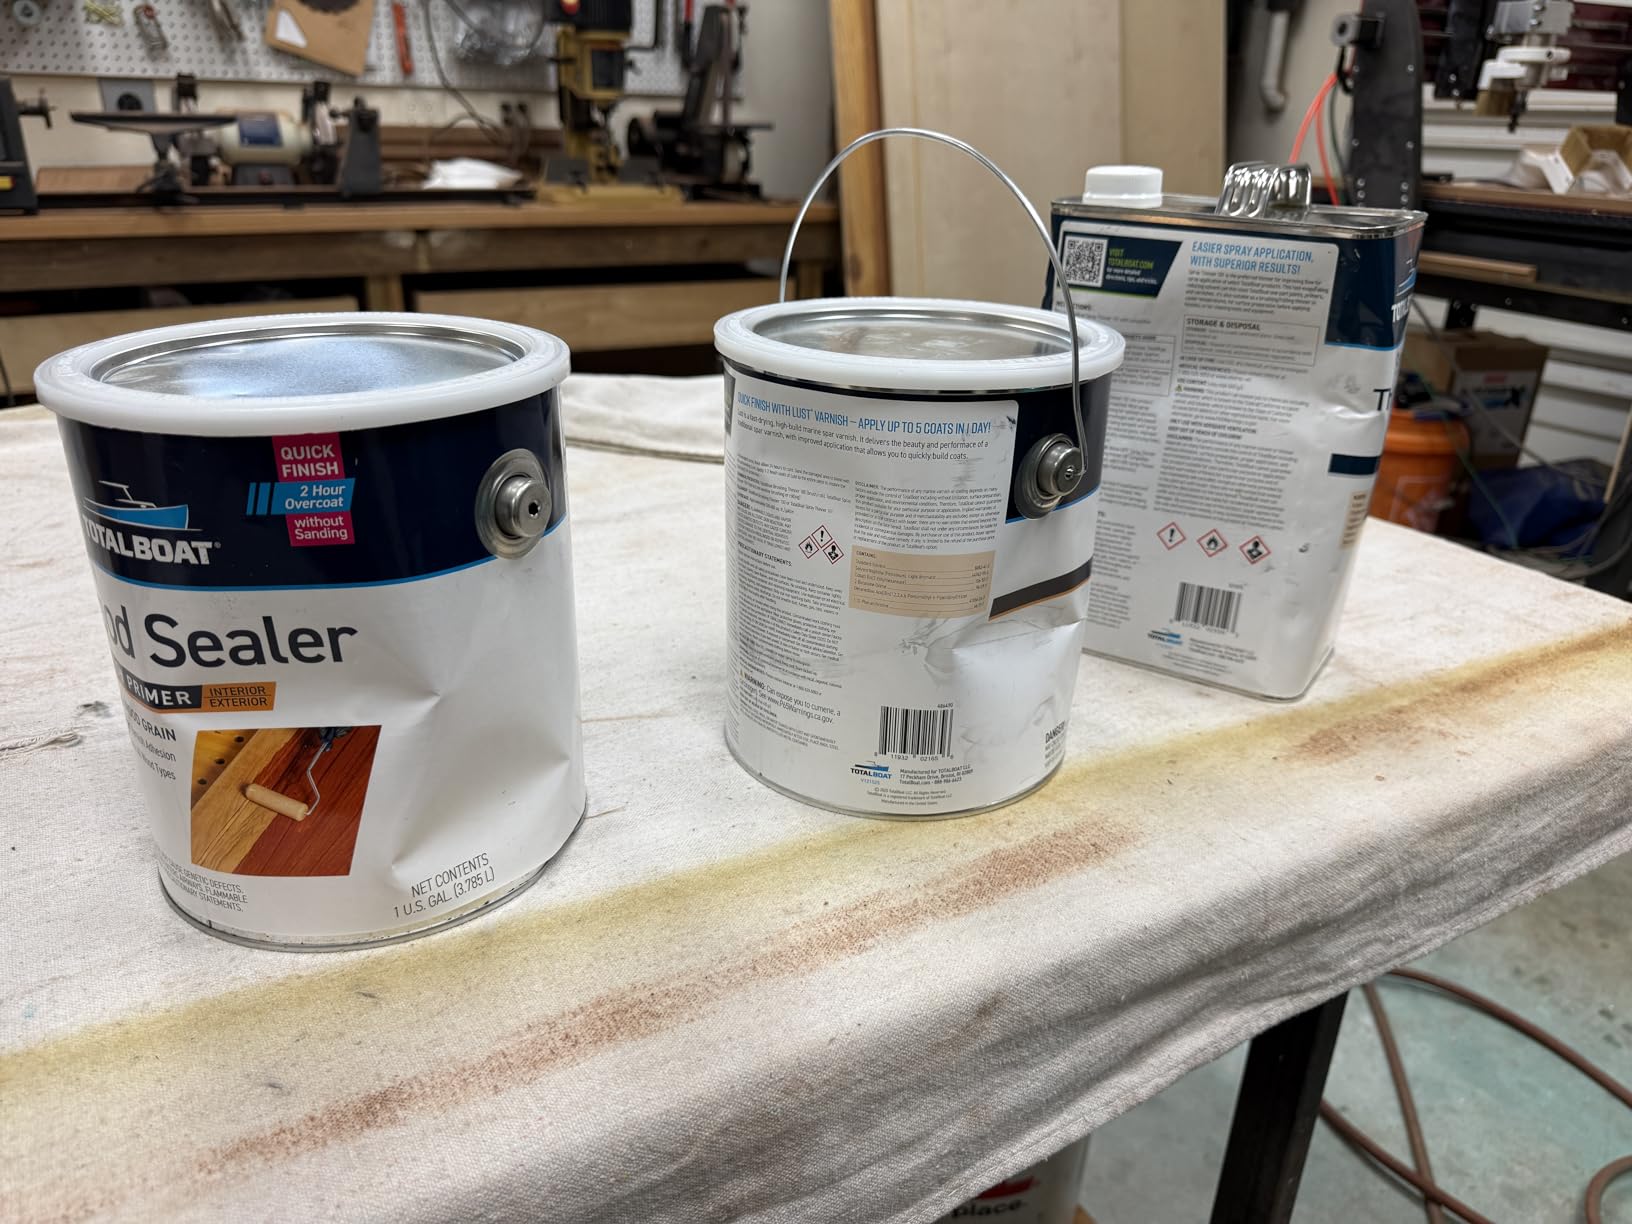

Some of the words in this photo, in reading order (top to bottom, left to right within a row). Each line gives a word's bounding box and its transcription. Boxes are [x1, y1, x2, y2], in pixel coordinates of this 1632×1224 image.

[1192, 242, 1222, 254] EASIER
[1224, 244, 1252, 257] SPRAY
[1253, 248, 1314, 263] APPLICATION,
[1190, 256, 1212, 267] WITH
[1213, 258, 1256, 272] SUPERIOR
[1186, 318, 1218, 328] STORAGE
[1226, 322, 1260, 330] DISPOSAL
[750, 396, 770, 412] FINISH
[772, 401, 791, 416] WITH
[814, 410, 848, 426] VARNISH
[858, 417, 886, 432] APPLY
[888, 420, 900, 432] UP
[902, 421, 914, 434] TO
[916, 422, 922, 434] 5
[924, 422, 954, 435] COATS
[956, 422, 964, 434] IN
[971, 422, 991, 434] DAY!
[775, 420, 802, 432] high-build
[803, 426, 821, 436] marine
[822, 429, 834, 439] spar
[836, 432, 858, 442] varnish.
[860, 434, 864, 442] It
[865, 436, 890, 446] delivers
[891, 438, 901, 447] the
[903, 439, 925, 450] beauty
[926, 440, 938, 449] and
[280, 444, 336, 461] QUICK
[786, 432, 797, 440] with
[798, 435, 822, 448] improved
[824, 439, 853, 452] application
[854, 444, 865, 454] that
[866, 446, 886, 457] allows
[888, 450, 899, 459] you
[908, 452, 931, 461] quickly
[932, 452, 948, 460] build
[282, 461, 340, 478] FINISH
[300, 486, 308, 496] 2
[312, 484, 346, 496] Hour
[285, 497, 344, 510] Overcoat
[294, 516, 344, 528] without
[296, 528, 348, 541] Sanding
[144, 613, 358, 668] Sealer
[126, 674, 192, 706] PRIMER
[210, 686, 266, 697] INTERIOR
[766, 685, 776, 695] Can
[776, 690, 792, 702] expose
[794, 698, 803, 708] you
[210, 697, 268, 708] EXTERIOR
[142, 718, 176, 742] GRAIN
[154, 762, 176, 780] Types
[850, 768, 892, 780] TOTALBOAT
[412, 878, 432, 898] NET
[435, 852, 489, 888] CONTENTS
[206, 886, 248, 904] FLAMMABLE
[210, 878, 244, 894] DEFECTS.
[394, 906, 399, 918] 1
[403, 900, 426, 916] U.S.
[453, 873, 484, 898] (3.785
[485, 866, 495, 882] L)
[199, 892, 244, 912] STATEMENTS.
